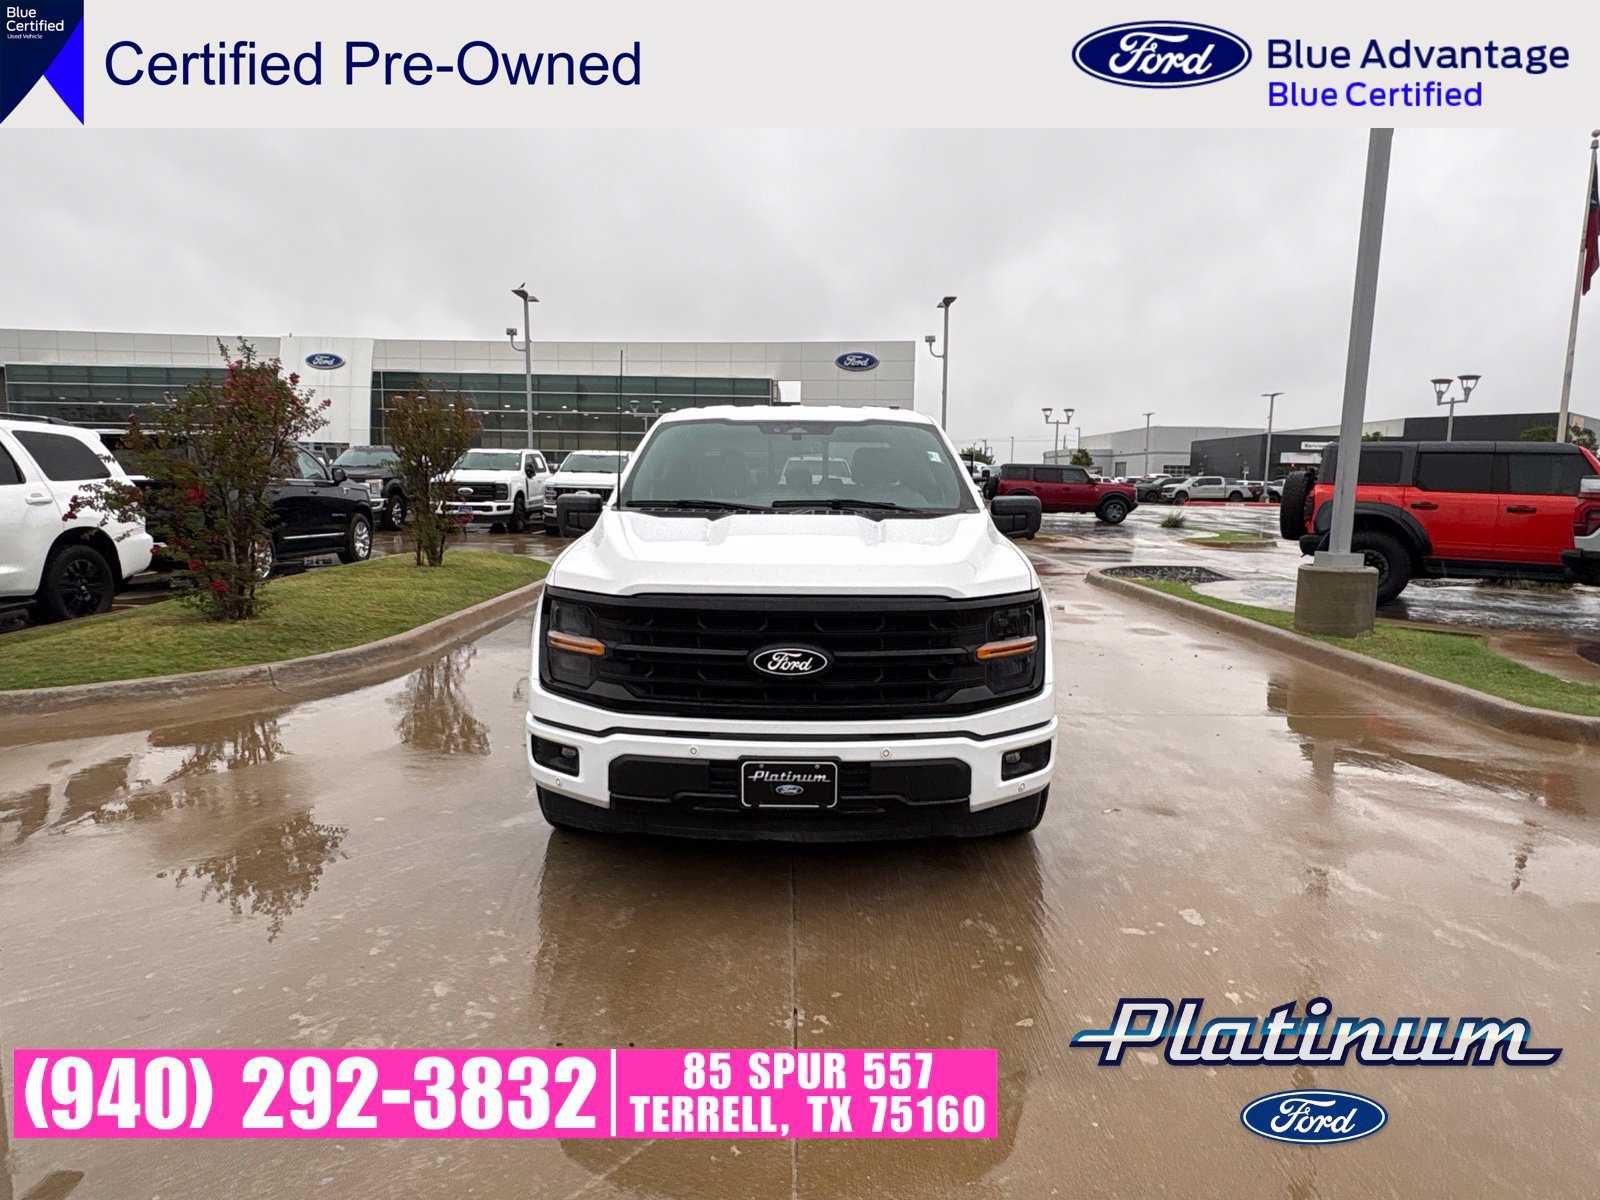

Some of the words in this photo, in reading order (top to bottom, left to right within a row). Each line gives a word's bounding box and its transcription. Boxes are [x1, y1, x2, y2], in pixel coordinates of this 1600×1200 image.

[312, 355, 336, 366] Ford
[843, 354, 870, 367] Ford
[767, 651, 814, 671] Ford
[747, 770, 831, 783] Platinum
[780, 785, 800, 794] Ford
